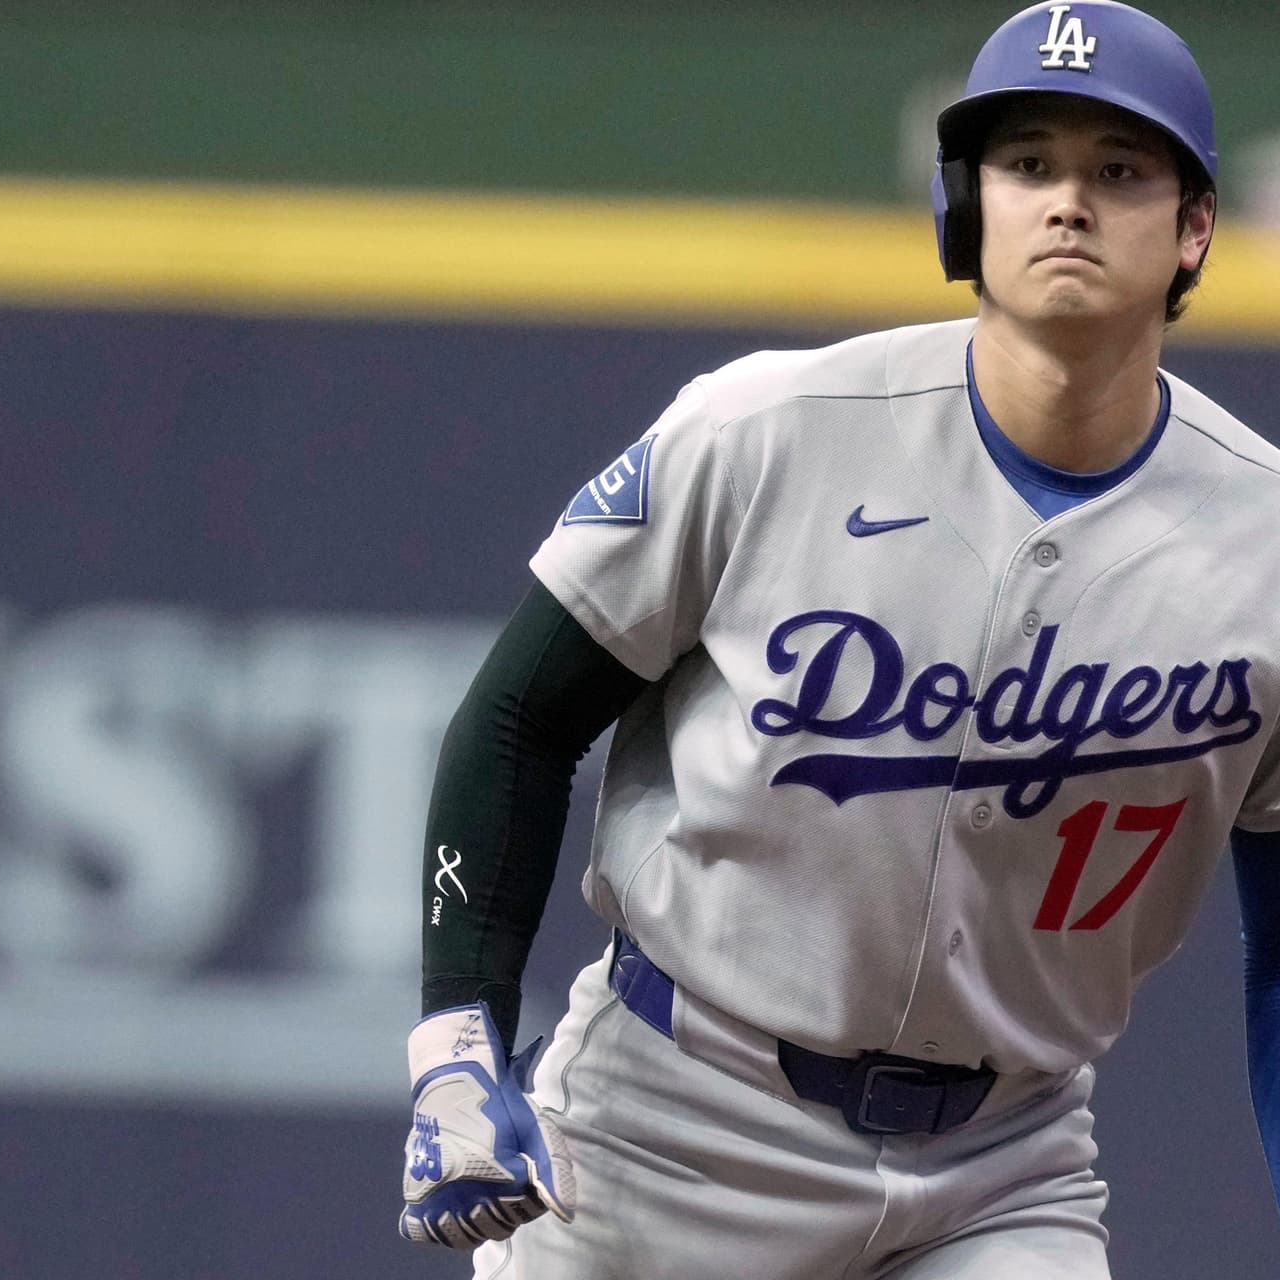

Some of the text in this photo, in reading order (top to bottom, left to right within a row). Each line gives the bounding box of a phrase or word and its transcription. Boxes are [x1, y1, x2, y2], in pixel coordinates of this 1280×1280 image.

[1039, 5, 1097, 69] LA
[750, 609, 1262, 820] Dodgers
[1033, 797, 1189, 932] 17
